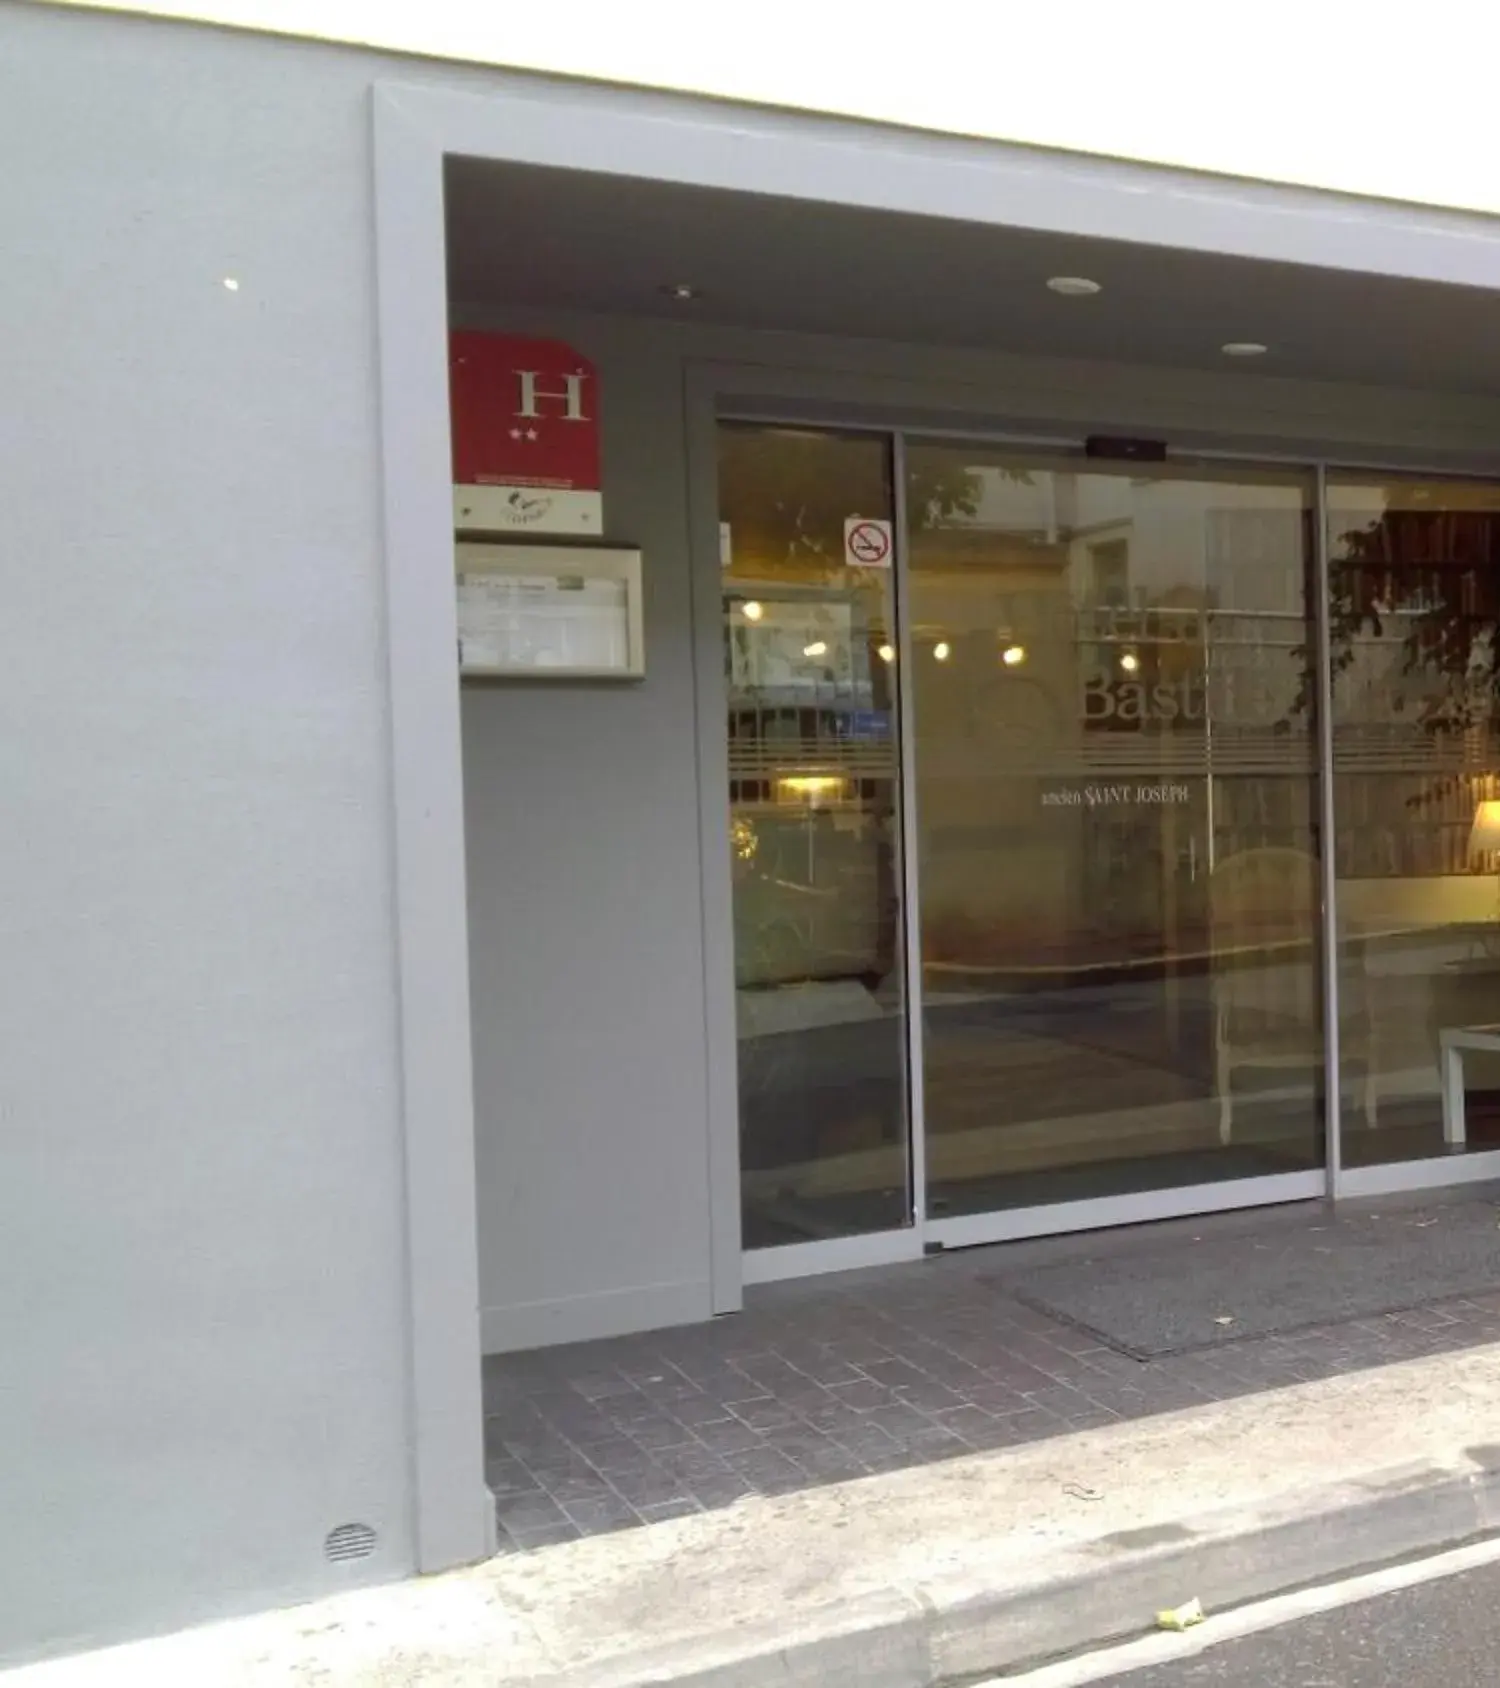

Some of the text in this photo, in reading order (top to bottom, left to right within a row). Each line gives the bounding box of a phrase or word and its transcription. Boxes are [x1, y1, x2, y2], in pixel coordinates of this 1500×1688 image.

[512, 370, 592, 421] H
[1084, 784, 1131, 809] SAINT
[1135, 784, 1189, 804] JOSEPH
